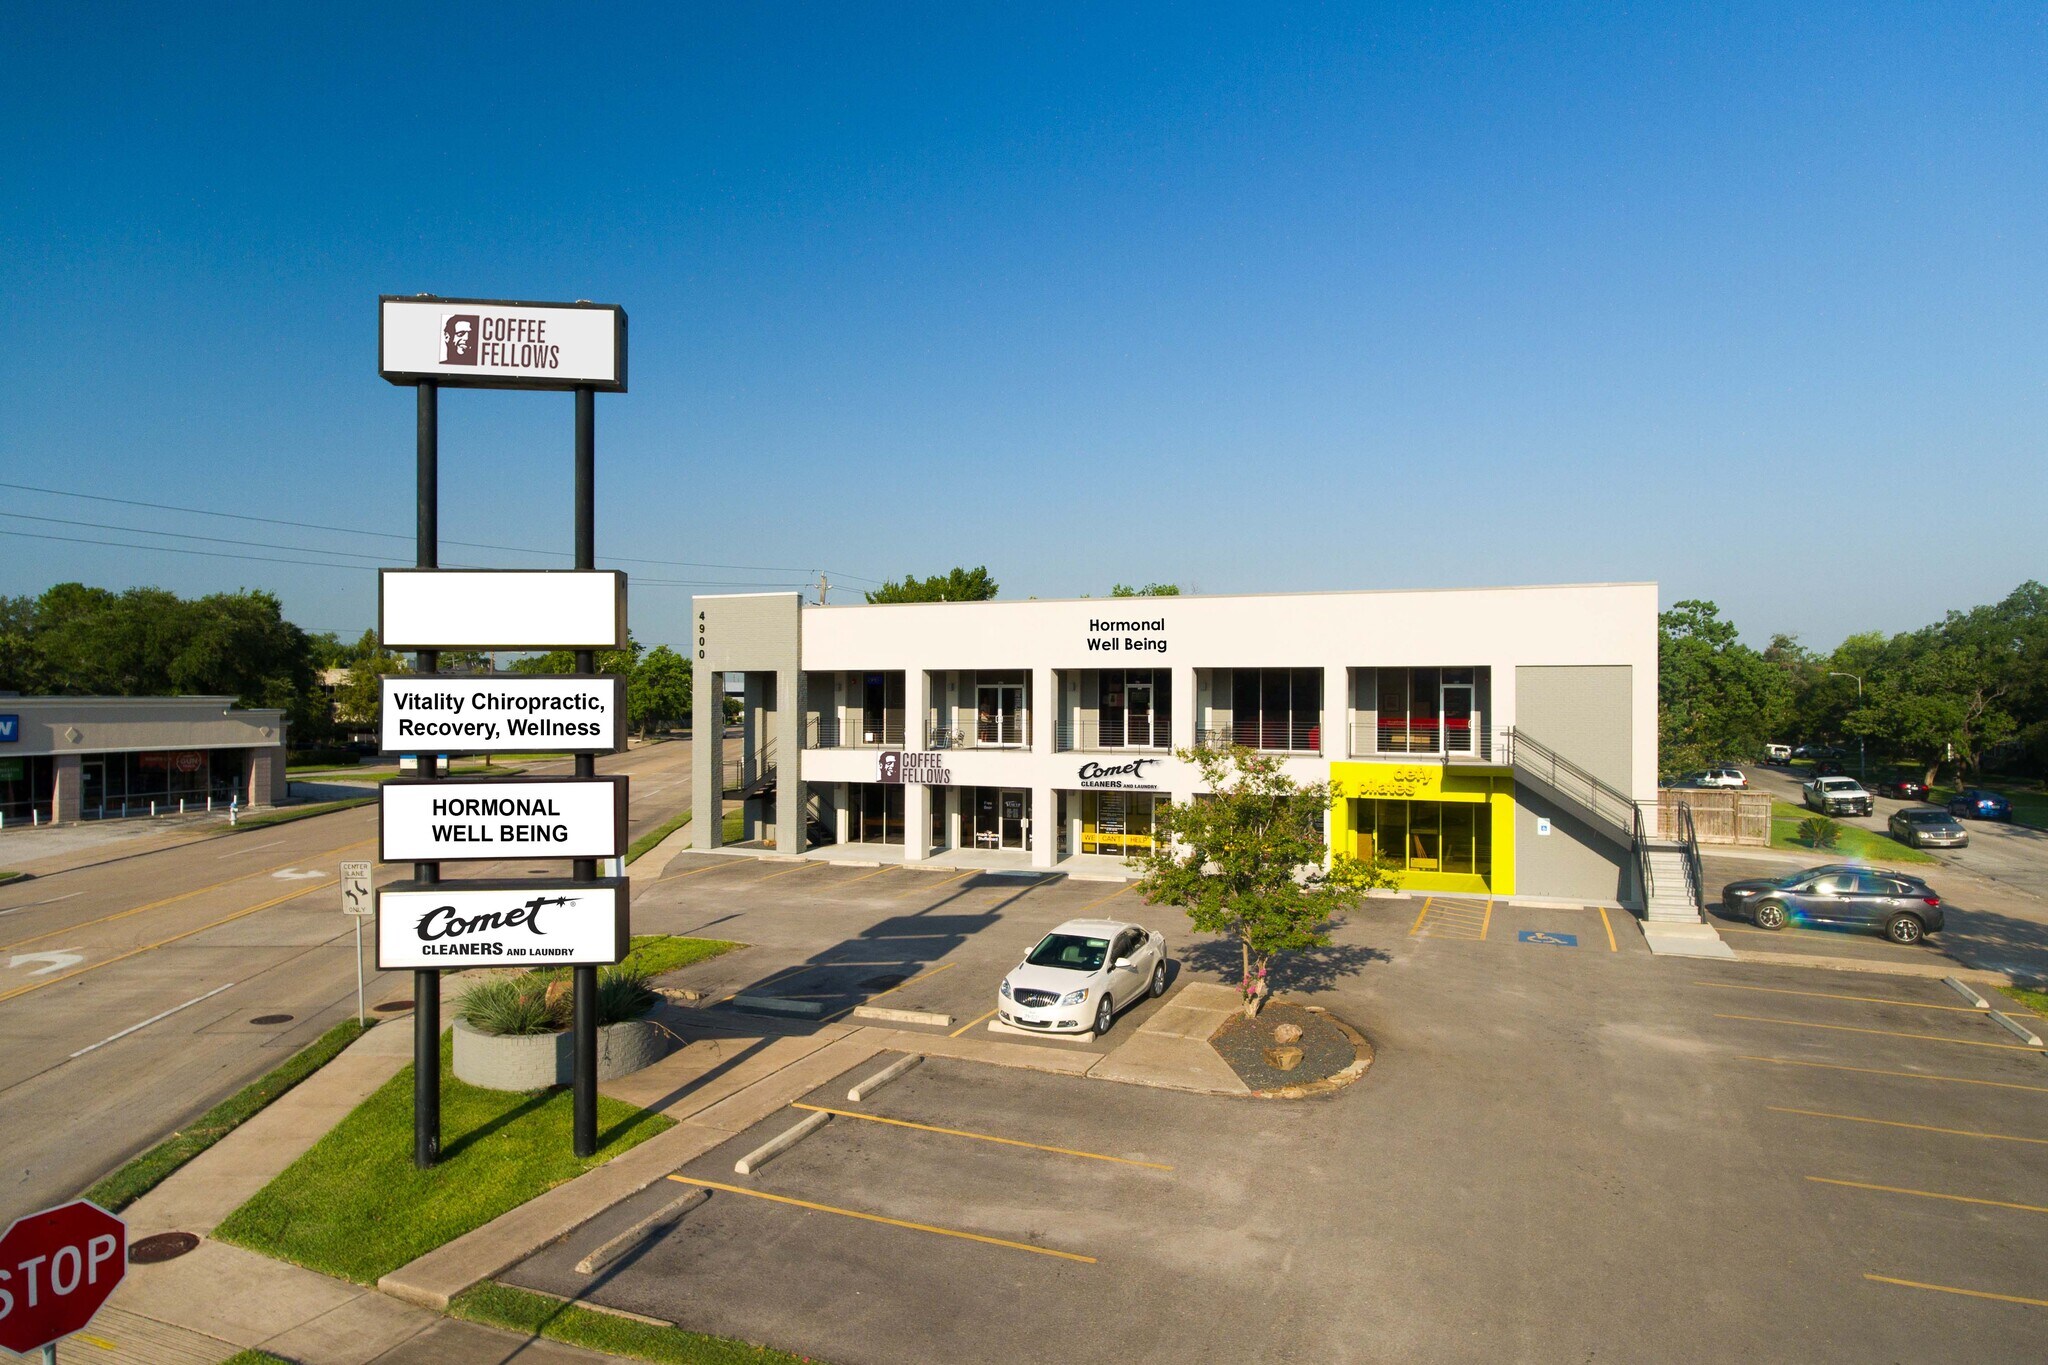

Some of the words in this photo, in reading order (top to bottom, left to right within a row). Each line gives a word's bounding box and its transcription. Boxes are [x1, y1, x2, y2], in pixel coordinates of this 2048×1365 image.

[482, 317, 546, 344] COFFEE
[481, 342, 559, 369] FELLOWS
[1089, 617, 1165, 632] Hormonal
[1087, 637, 1119, 651] Well
[1125, 637, 1167, 653] Being
[394, 692, 465, 714] Vitality
[472, 692, 605, 714] Chiropractic,
[399, 718, 500, 740] Recovery,
[507, 718, 601, 736] Wellness
[902, 752, 942, 768] COFFEE
[1077, 758, 1162, 779] Comet
[902, 768, 951, 784] FELLOWS
[1081, 780, 1122, 788] CLEANERS
[1393, 765, 1433, 786] defy
[1358, 778, 1417, 798] pilates
[433, 798, 560, 817] HORMONAL
[432, 825, 494, 842] WELL
[500, 824, 568, 843] BEING
[413, 897, 584, 941] Comet
[422, 942, 503, 956] CLEANERS
[506, 948, 527, 956] AND
[529, 948, 575, 956] LAUNDRY
